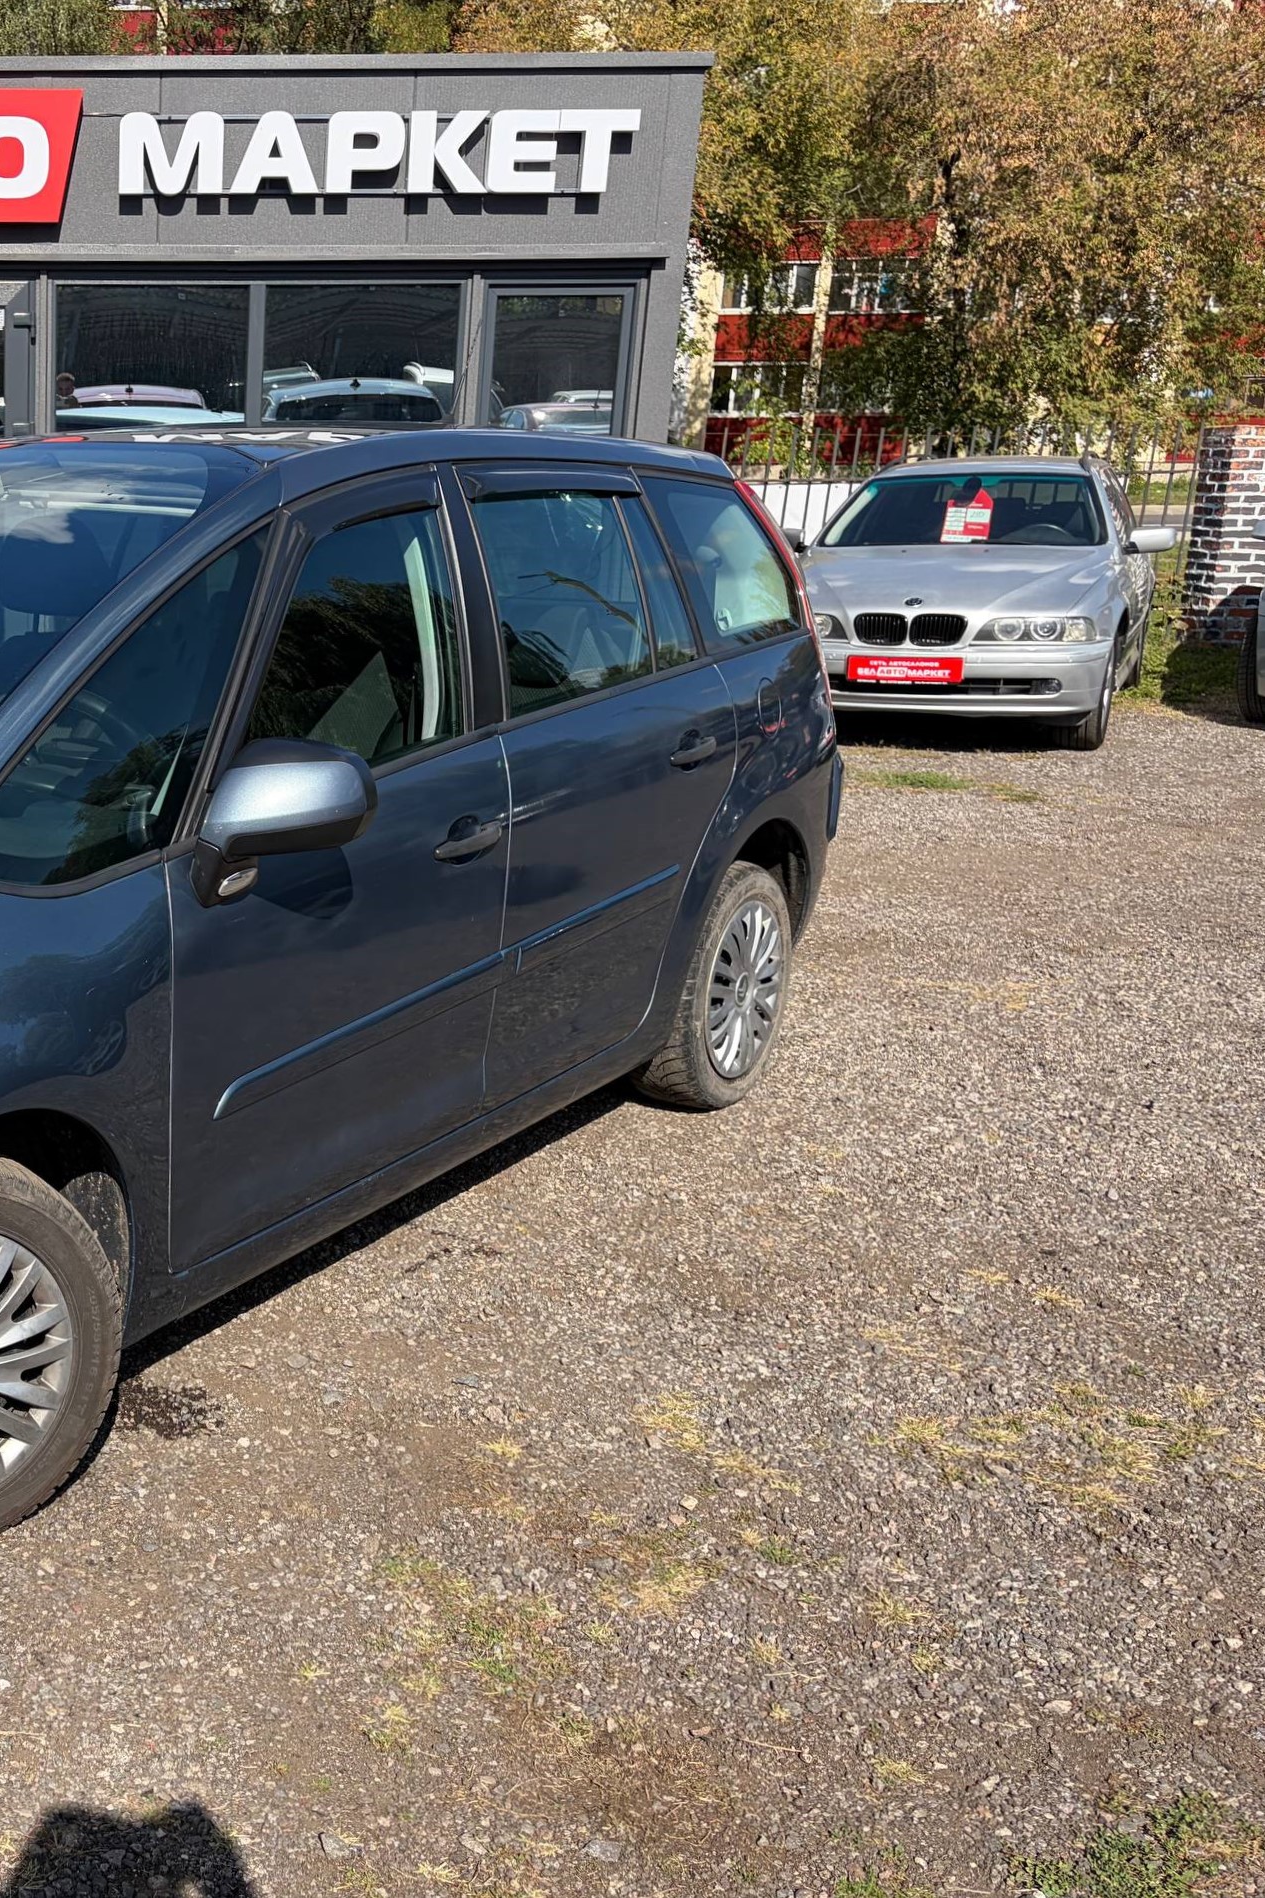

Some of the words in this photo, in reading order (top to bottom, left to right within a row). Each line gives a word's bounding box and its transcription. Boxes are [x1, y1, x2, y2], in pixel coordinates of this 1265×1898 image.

[118, 108, 642, 196] МАРКЕТ
[878, 667, 906, 676] АВТО
[907, 669, 951, 678] МАРКЕТ
